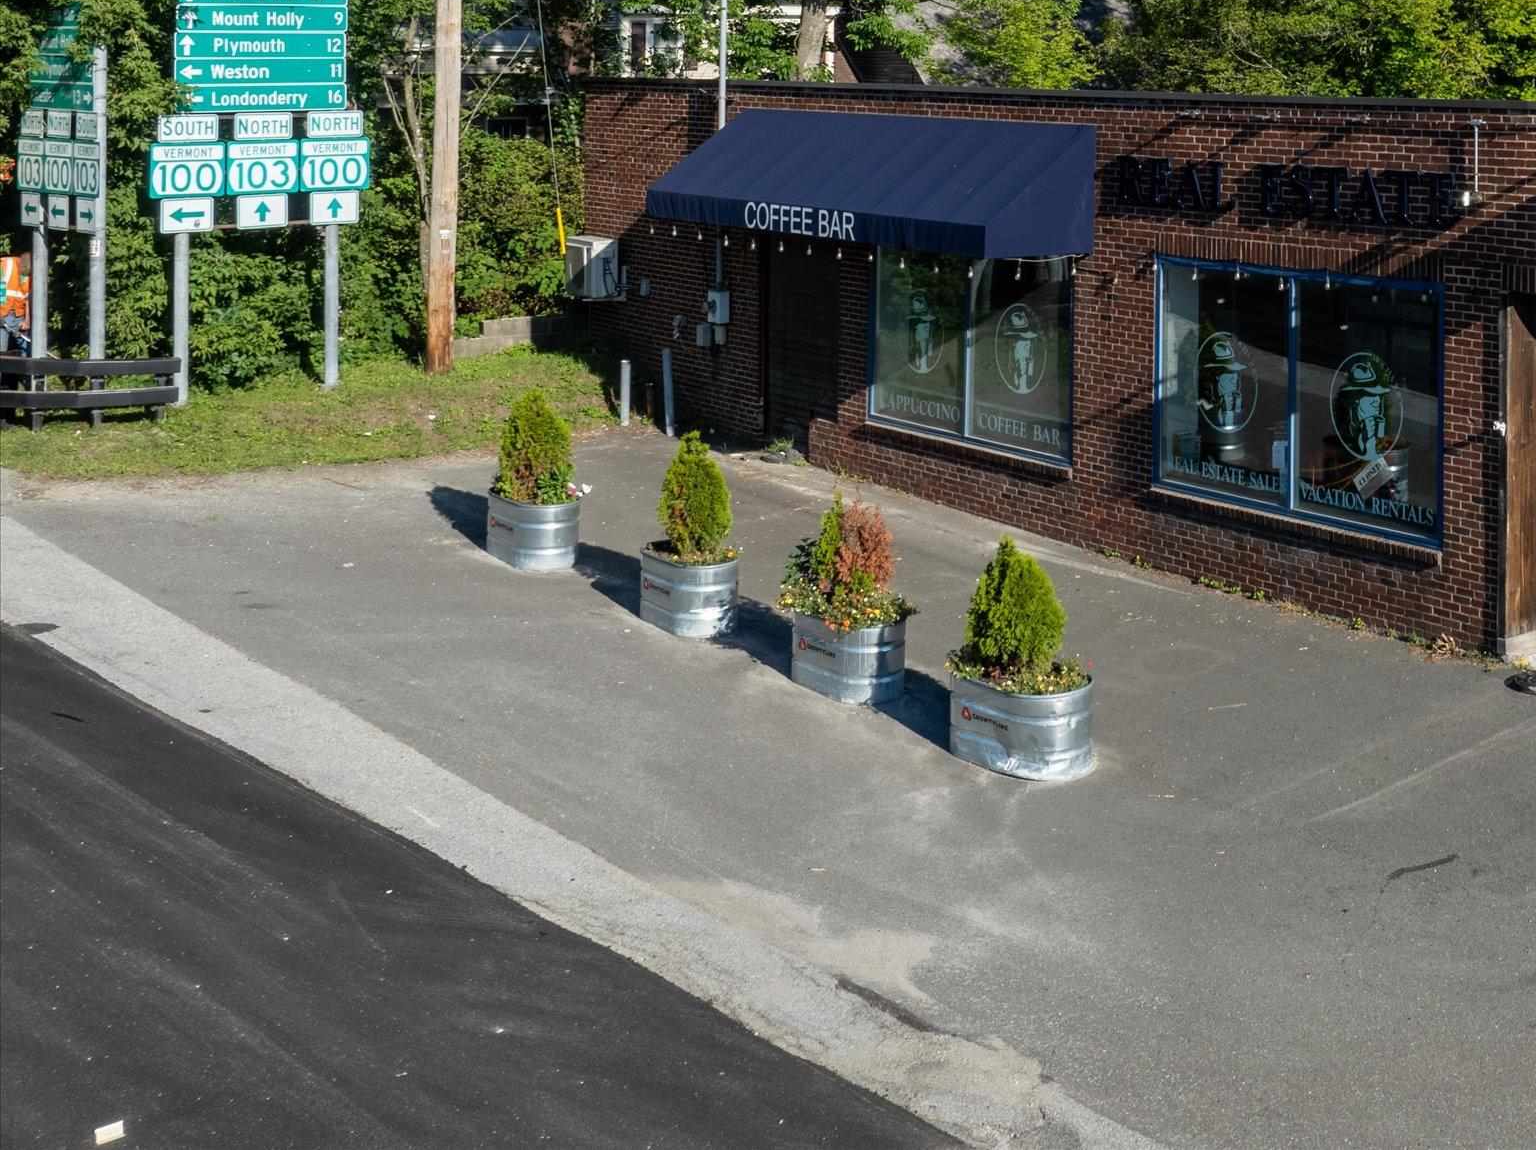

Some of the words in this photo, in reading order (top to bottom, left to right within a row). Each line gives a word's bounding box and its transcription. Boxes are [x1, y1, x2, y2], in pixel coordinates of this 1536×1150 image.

[211, 11, 259, 26] Mount
[266, 11, 305, 30] Holly
[333, 11, 344, 26] 9
[213, 38, 286, 56] Plymouth
[327, 38, 342, 53] 12
[210, 64, 270, 79] Weston
[330, 63, 342, 78] 11
[211, 91, 308, 111] Londonderry
[327, 90, 343, 104] 16
[162, 119, 214, 137] SOUTH
[238, 116, 289, 134] NORTH
[311, 114, 360, 132] NORTH
[163, 148, 213, 158] VERMONT
[239, 145, 287, 156] VERMONT
[312, 142, 359, 154] VERMONT
[20, 157, 41, 187] 103
[46, 159, 70, 189] 100
[75, 161, 97, 192] 103
[159, 162, 217, 192] 100
[236, 160, 290, 189] 103
[308, 157, 361, 186] 100
[744, 201, 814, 236] COFFEE
[818, 209, 856, 242] BAR
[880, 393, 960, 423] APPUCCINO
[977, 412, 1027, 438] COFFEE
[1032, 424, 1061, 447] BAR
[1201, 461, 1246, 486] ESTATE
[1299, 480, 1365, 511] VACATION
[1371, 497, 1434, 526] RENTALS
